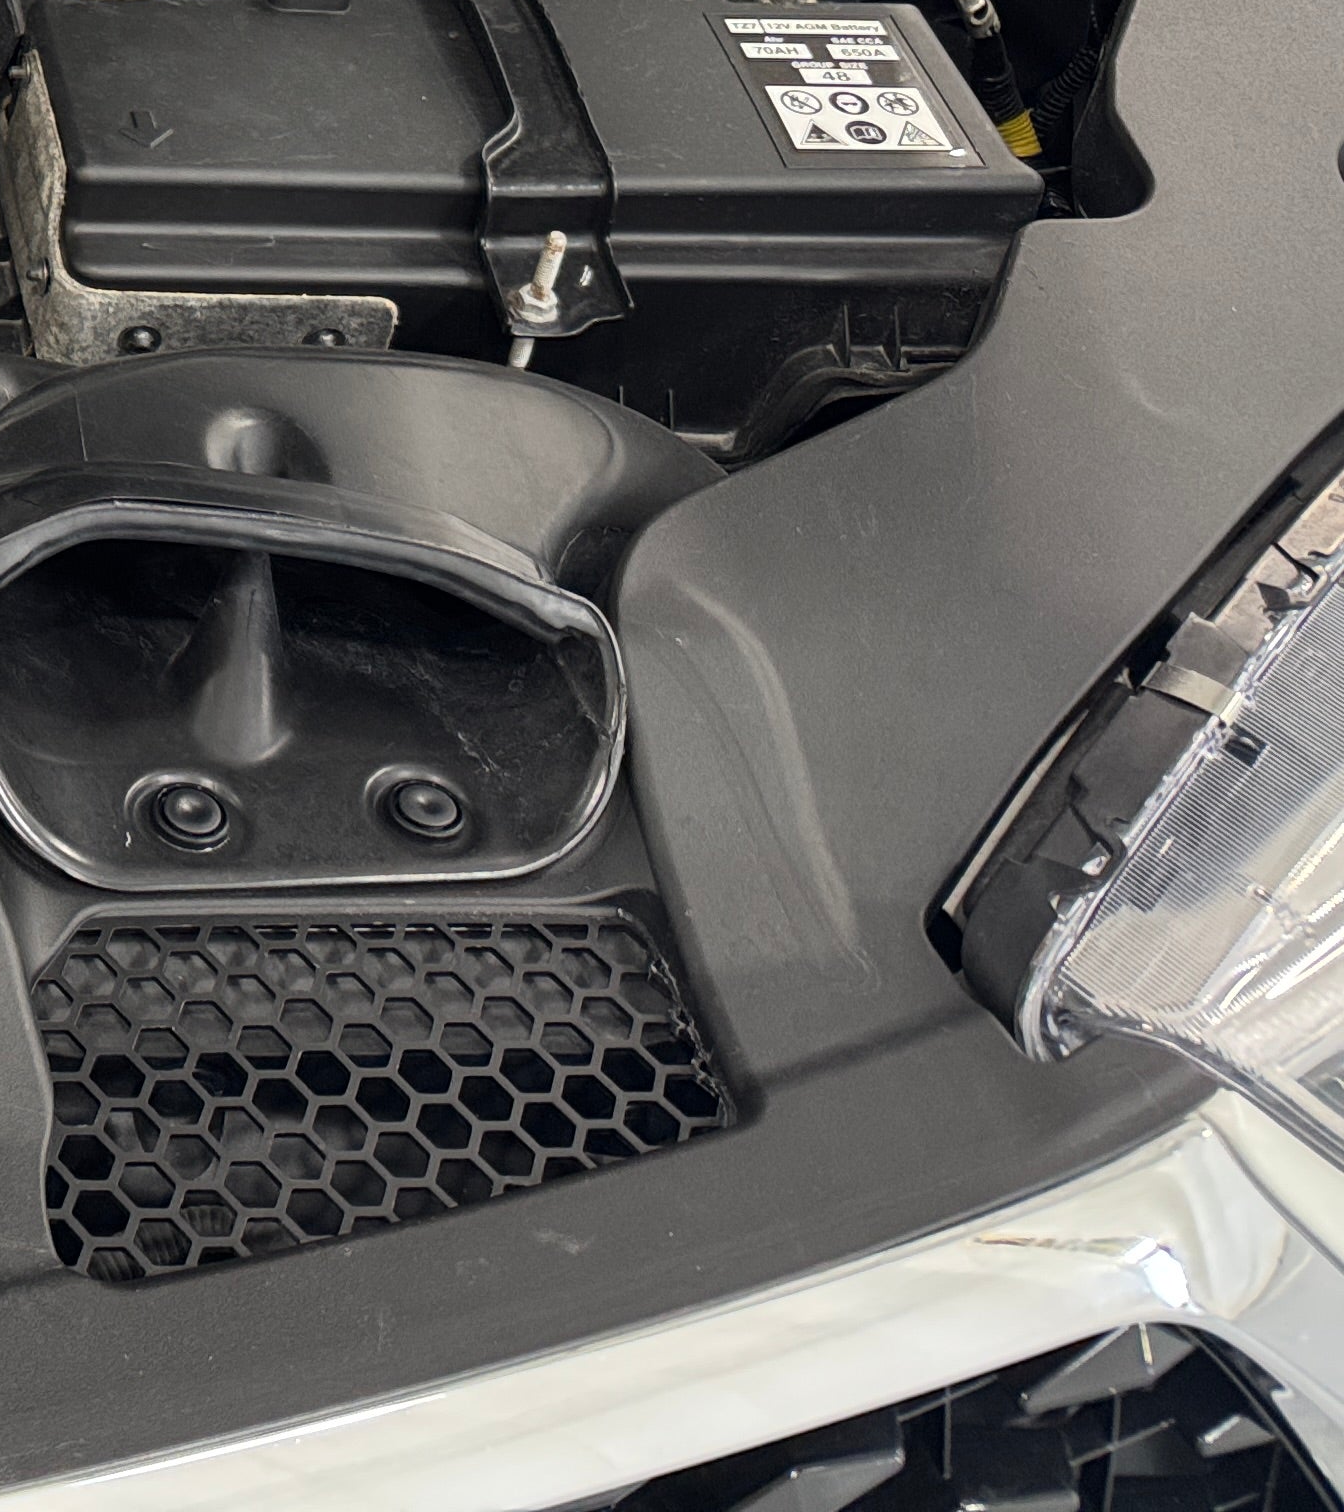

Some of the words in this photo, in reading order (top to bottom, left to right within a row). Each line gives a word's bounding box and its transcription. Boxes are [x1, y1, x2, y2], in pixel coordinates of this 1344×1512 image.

[830, 23, 879, 33] Battery
[752, 46, 800, 56] 70AH
[841, 48, 886, 57] 650A
[791, 61, 835, 69] GROUP
[823, 71, 851, 82] 48
